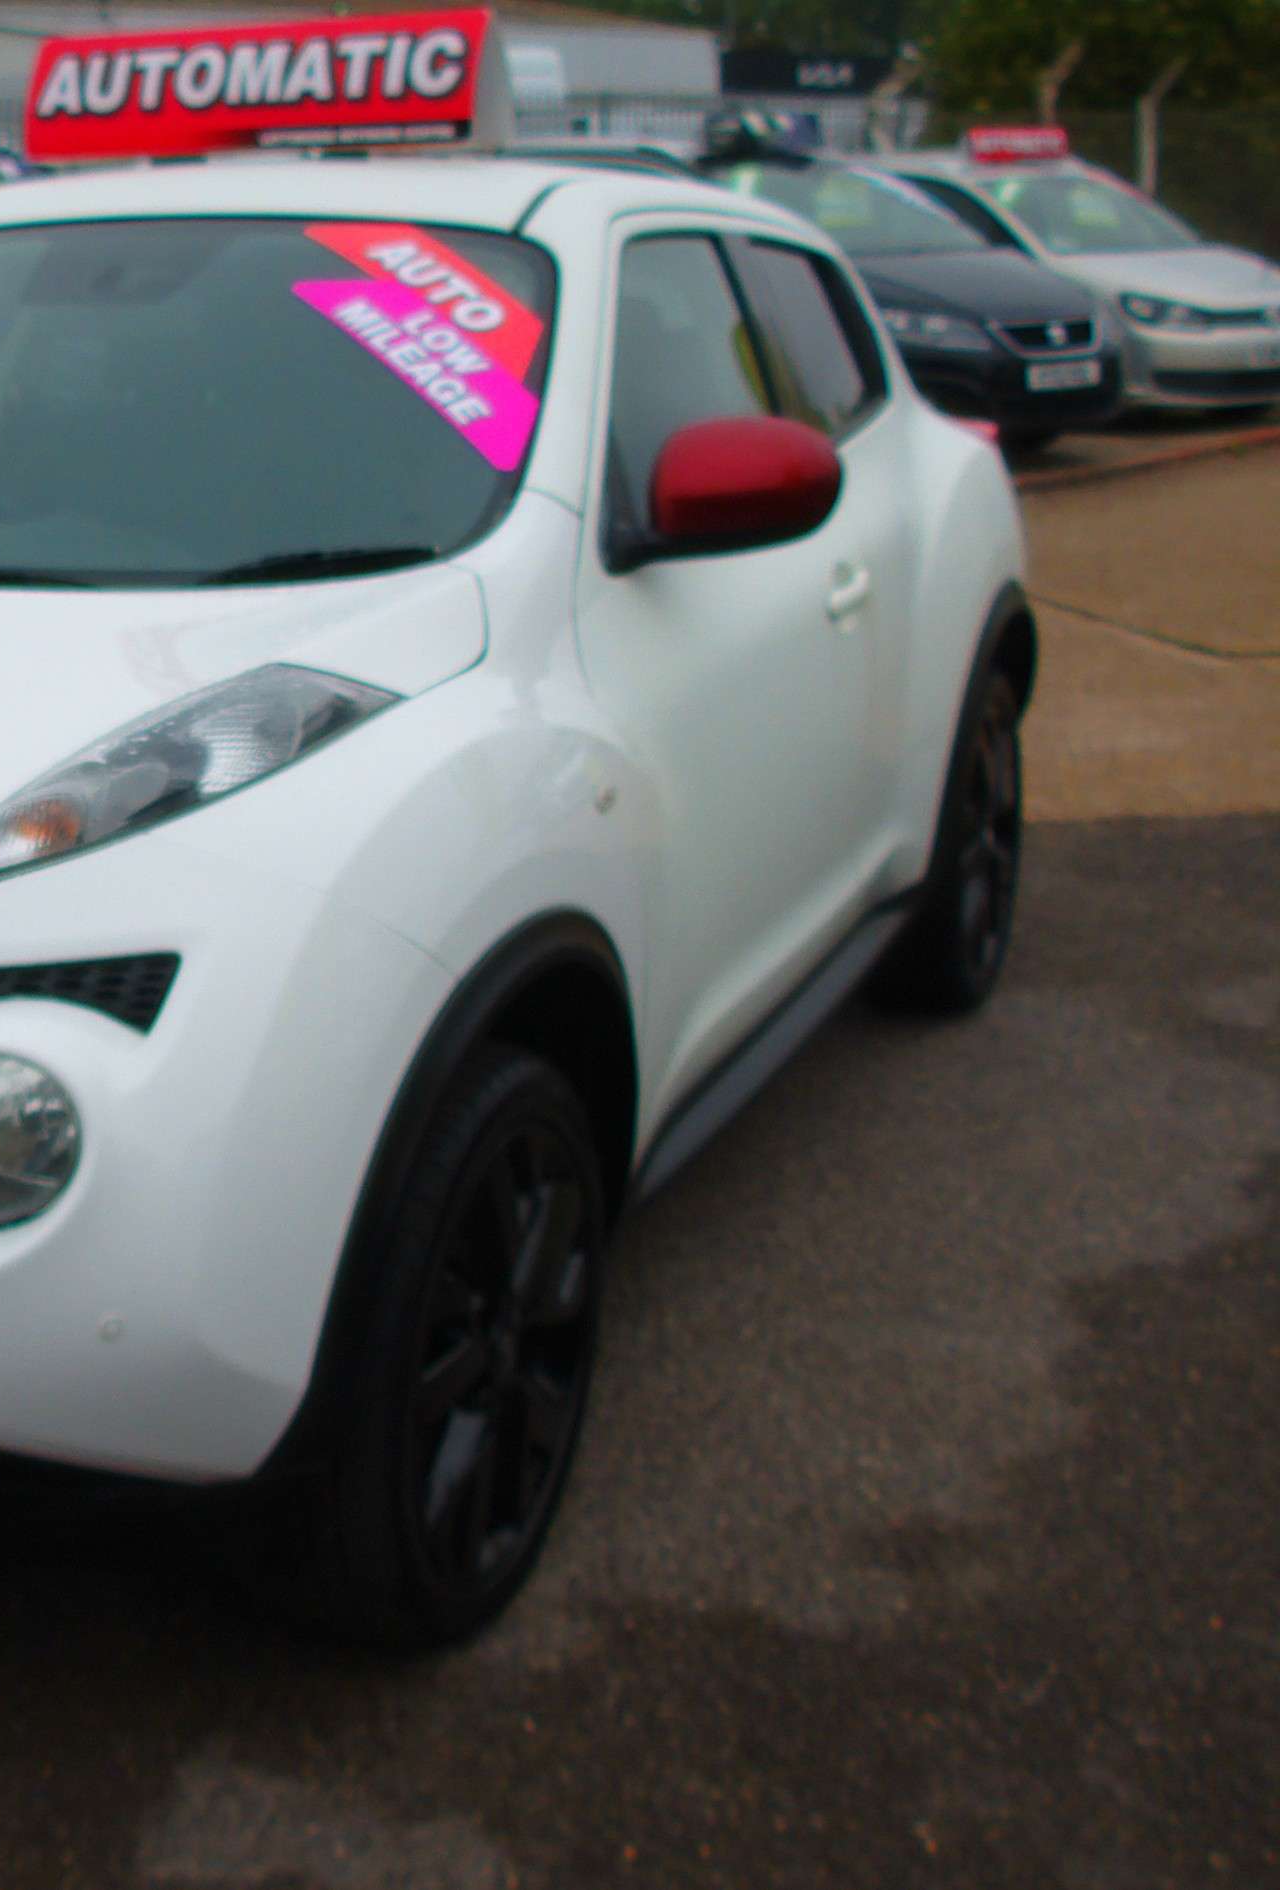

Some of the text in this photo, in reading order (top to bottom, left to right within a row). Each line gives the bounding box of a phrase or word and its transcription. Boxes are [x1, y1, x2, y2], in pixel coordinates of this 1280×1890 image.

[36, 29, 466, 118] AUTOMATIC
[366, 240, 505, 331] AUTO
[332, 299, 492, 426] MILEAGE
[397, 311, 492, 375] LOW
